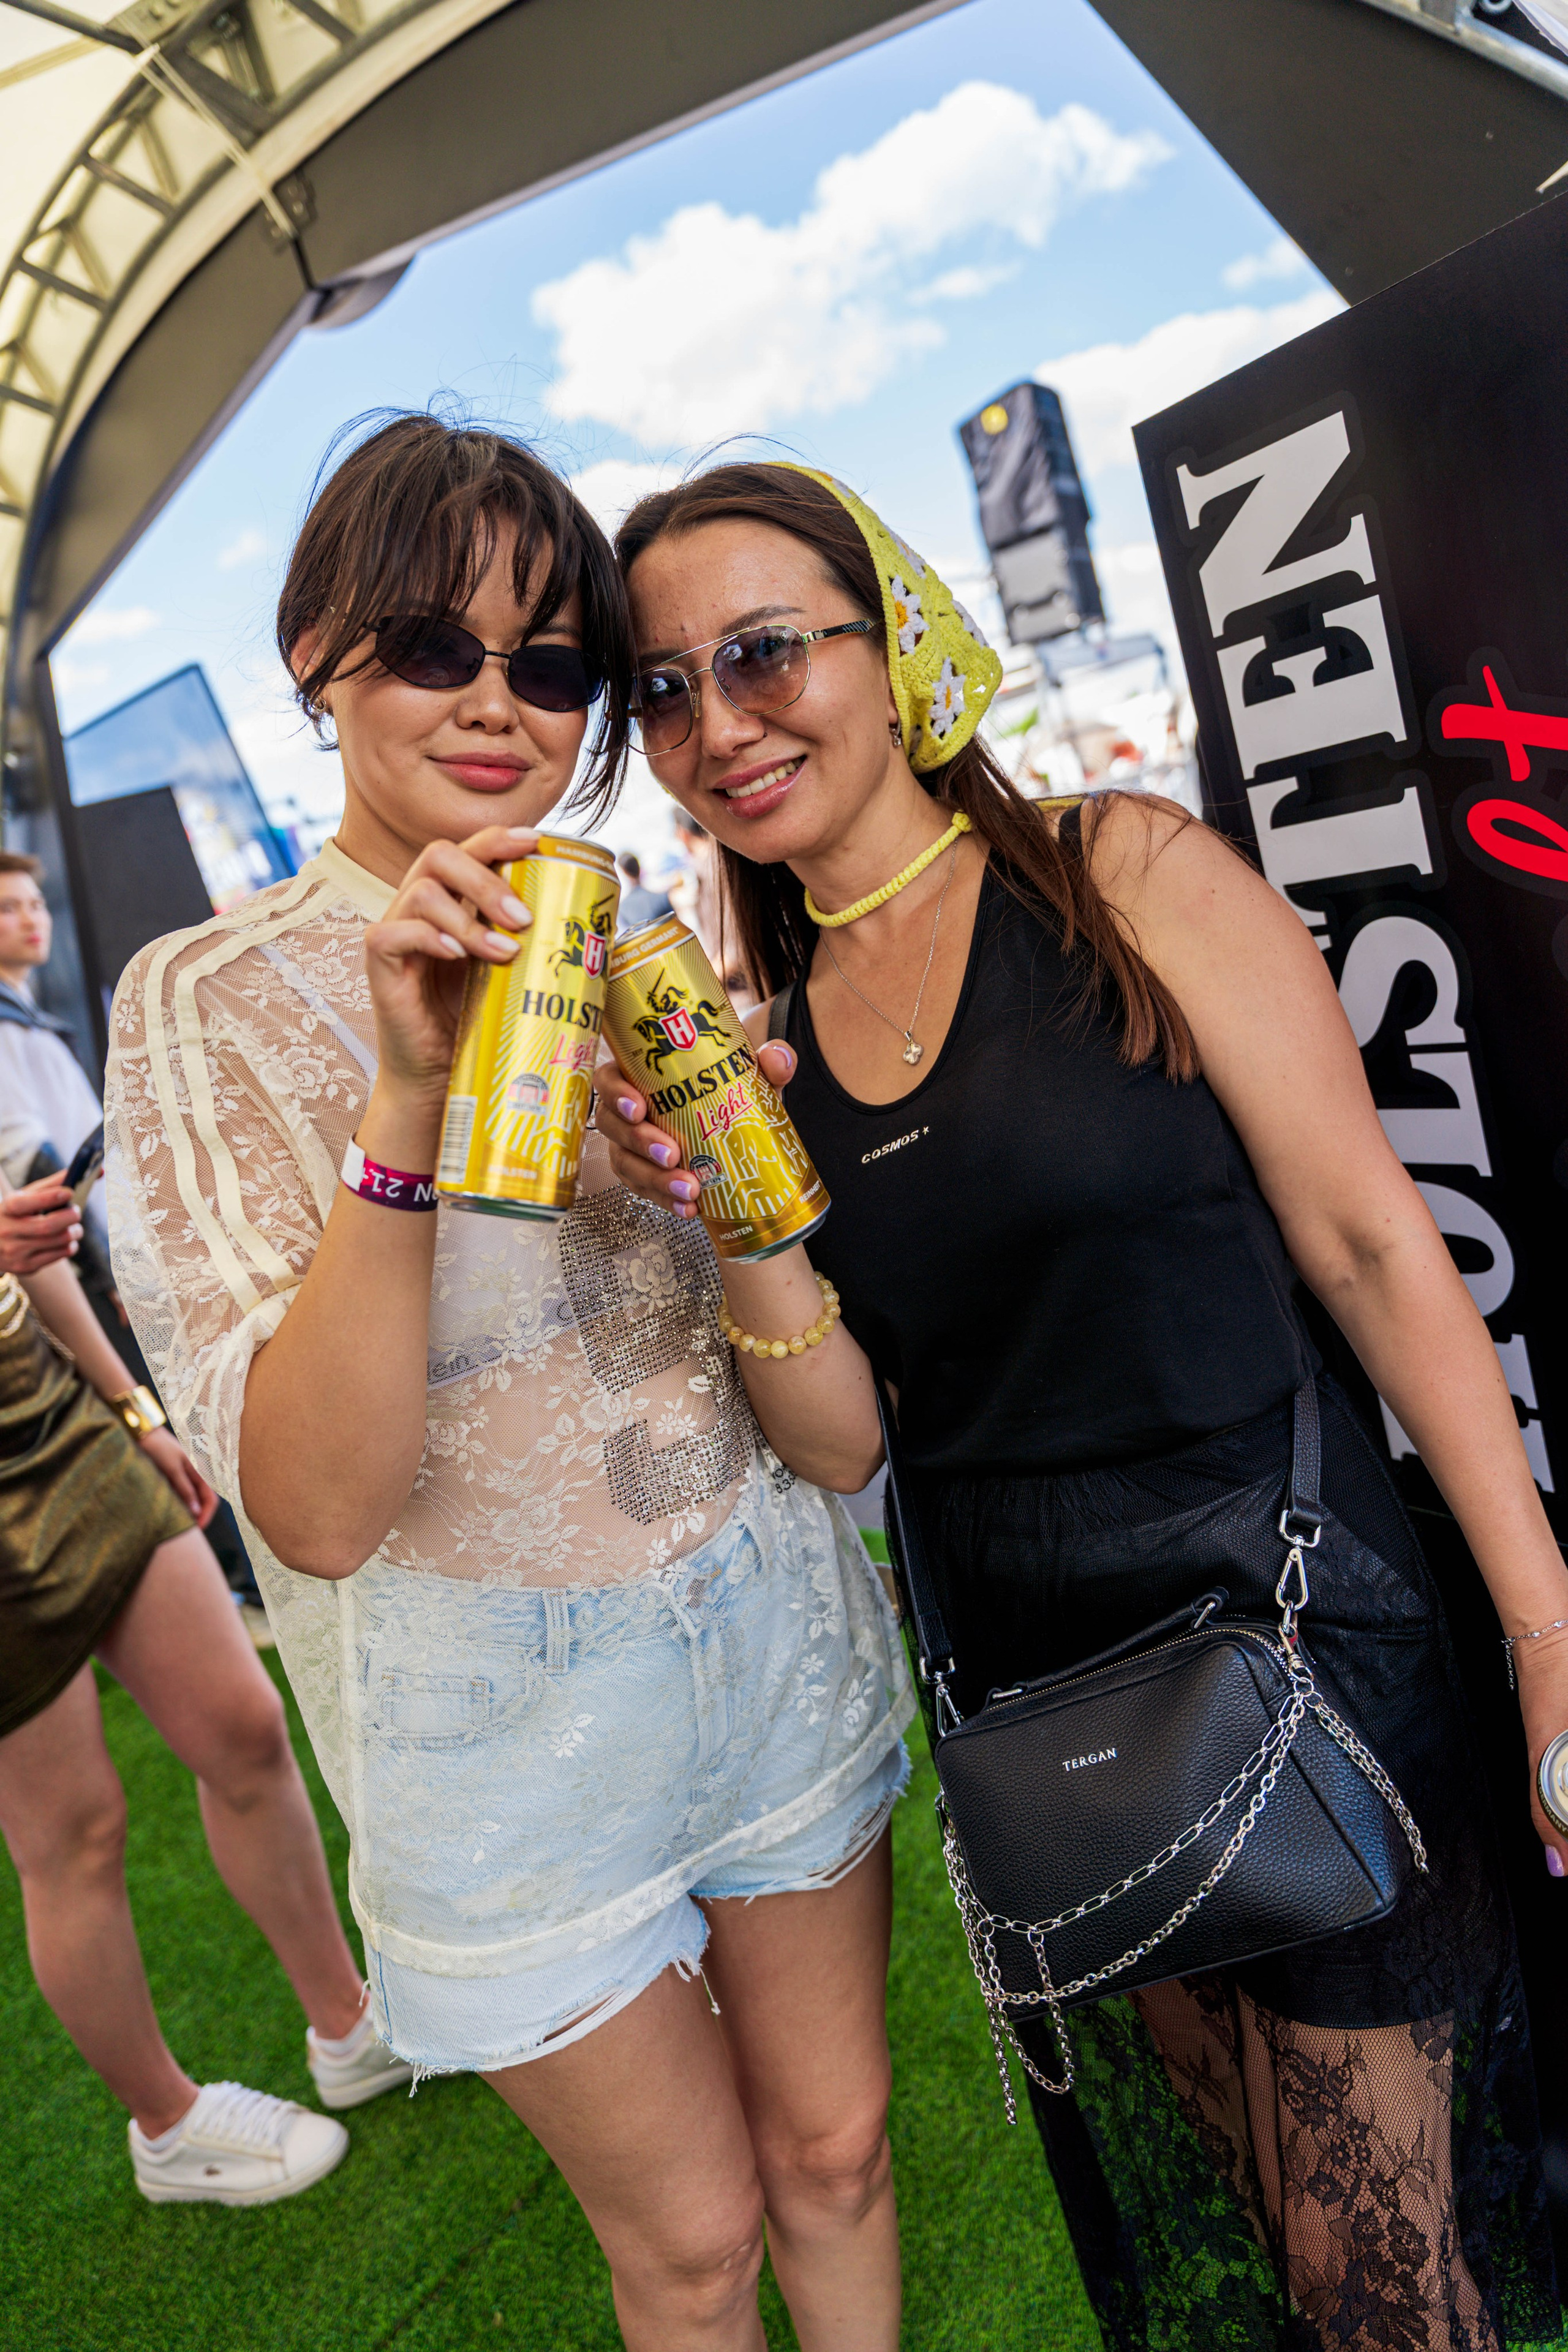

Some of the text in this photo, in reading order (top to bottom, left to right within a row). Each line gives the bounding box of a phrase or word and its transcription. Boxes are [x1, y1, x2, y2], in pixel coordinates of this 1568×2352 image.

[522, 990, 603, 1035] HOLST
[649, 1044, 755, 1115] HOLSTEN
[696, 1082, 751, 1141] Light
[861, 1129, 919, 1164] COSMOS
[719, 1225, 754, 1241] HOLSTEN
[1062, 1747, 1117, 1771] TERGAN
